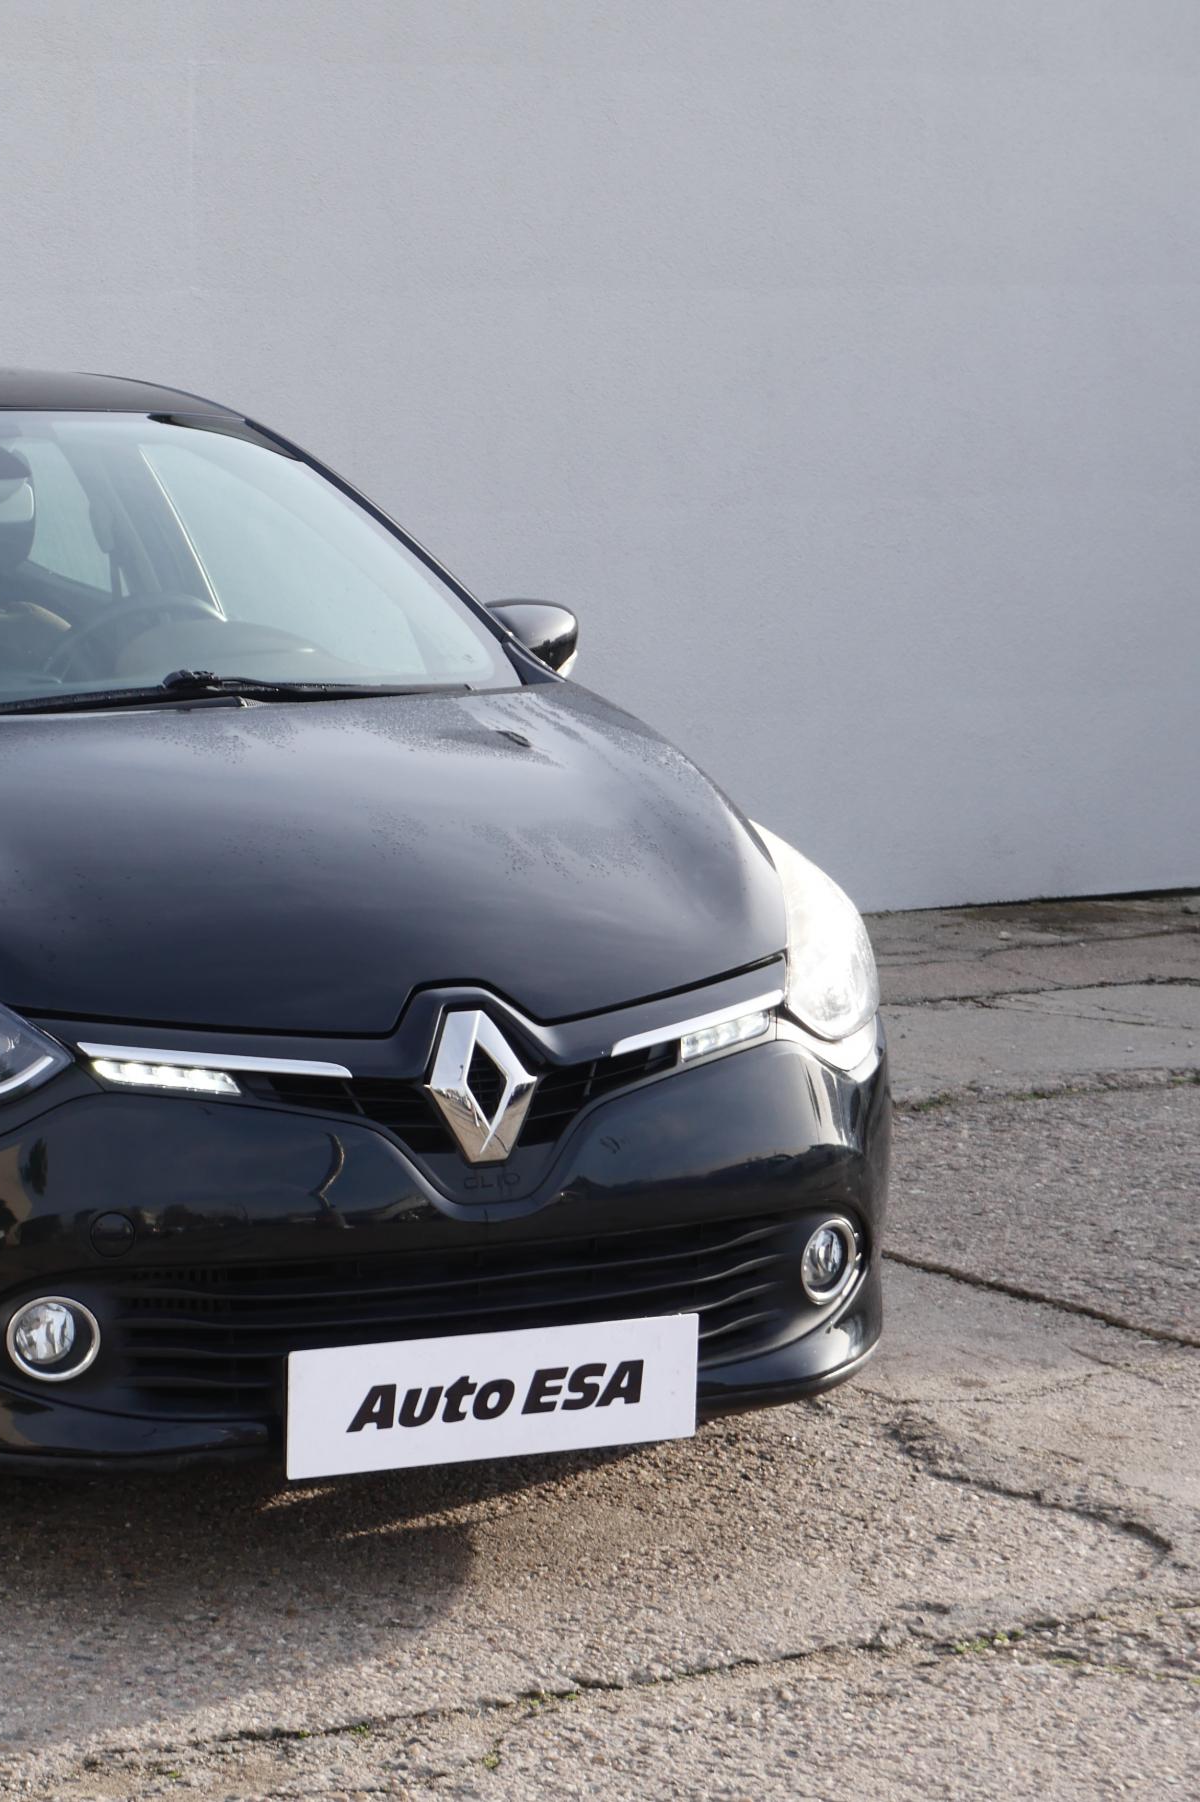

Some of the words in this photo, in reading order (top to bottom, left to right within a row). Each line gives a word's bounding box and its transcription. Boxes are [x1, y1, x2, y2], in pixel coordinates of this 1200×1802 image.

[464, 1172, 520, 1189] CLIO
[346, 1376, 515, 1433] Auto
[521, 1359, 645, 1414] ESA
